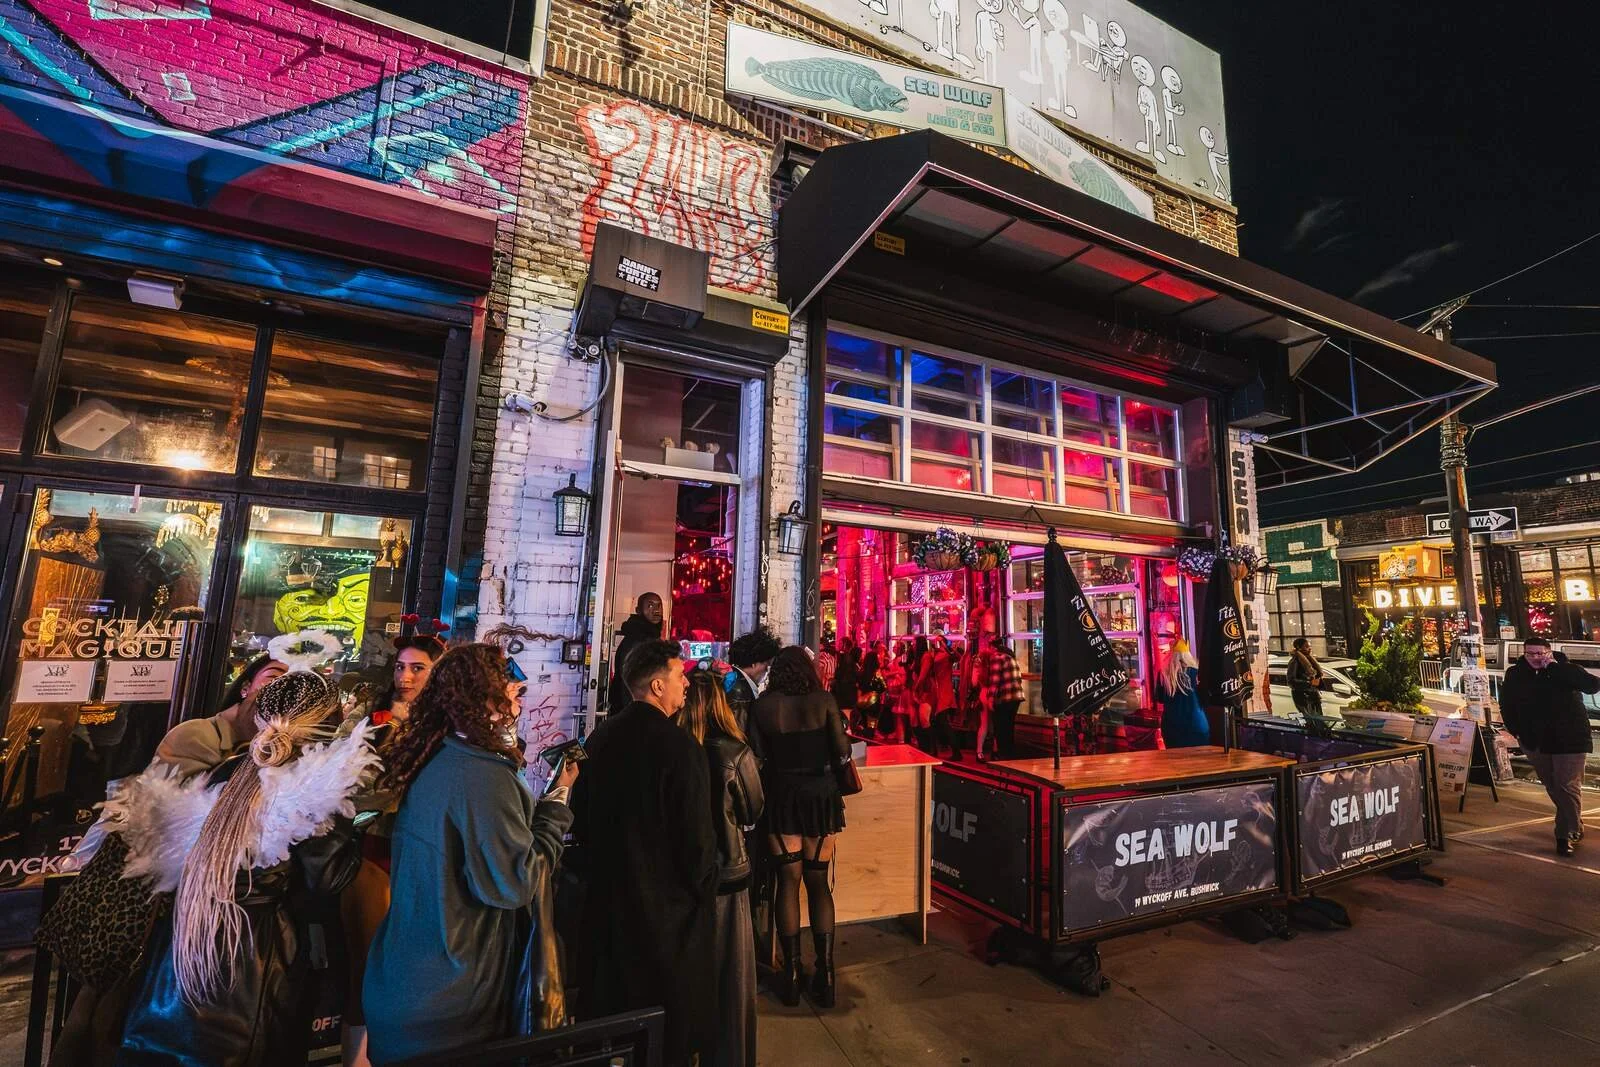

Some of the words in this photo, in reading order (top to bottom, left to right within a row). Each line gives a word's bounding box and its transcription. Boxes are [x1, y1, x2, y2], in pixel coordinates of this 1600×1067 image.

[904, 76, 939, 97] SEA
[943, 83, 992, 108] WOLF
[927, 112, 957, 129] LAND
[959, 121, 970, 132] &
[973, 122, 994, 136] SEA
[977, 113, 993, 124] OF
[1017, 110, 1040, 136] SEA
[1040, 124, 1072, 158] WOLF
[618, 263, 660, 284] CORTES
[622, 257, 658, 276] DANNY
[625, 273, 648, 287] NYC
[1231, 451, 1250, 536] SEA
[1475, 516, 1500, 527] WAY
[1241, 547, 1260, 664] OLF
[1375, 586, 1456, 609] DIVE
[1565, 579, 1589, 601] B
[1330, 796, 1360, 826] SEA
[1365, 786, 1399, 818] WOLF
[931, 800, 977, 842] OLF
[1115, 828, 1165, 867] SEA
[1174, 819, 1239, 857] WOLF
[931, 859, 960, 879] USHWICK
[1142, 891, 1172, 905] WYCKOFF
[1190, 883, 1219, 896] BUSHWICK
